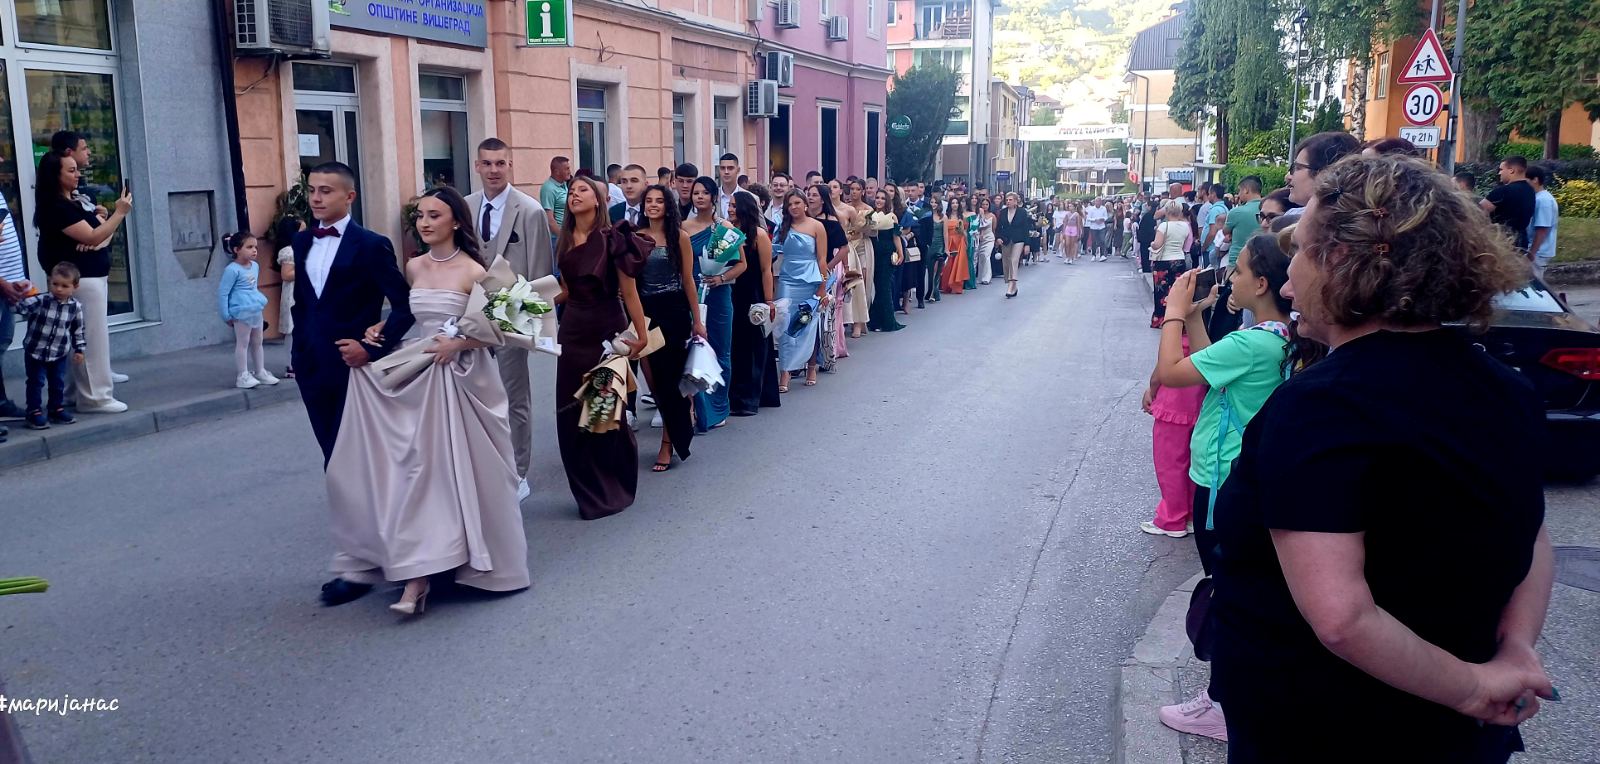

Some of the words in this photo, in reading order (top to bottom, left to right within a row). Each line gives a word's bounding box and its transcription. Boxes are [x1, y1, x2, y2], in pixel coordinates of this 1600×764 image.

[367, 3, 418, 24] ОПШТИНЕ
[423, 12, 471, 35] ВИШЕГРАД
[1410, 95, 1434, 115] 30
[1418, 133, 1427, 142] 21
